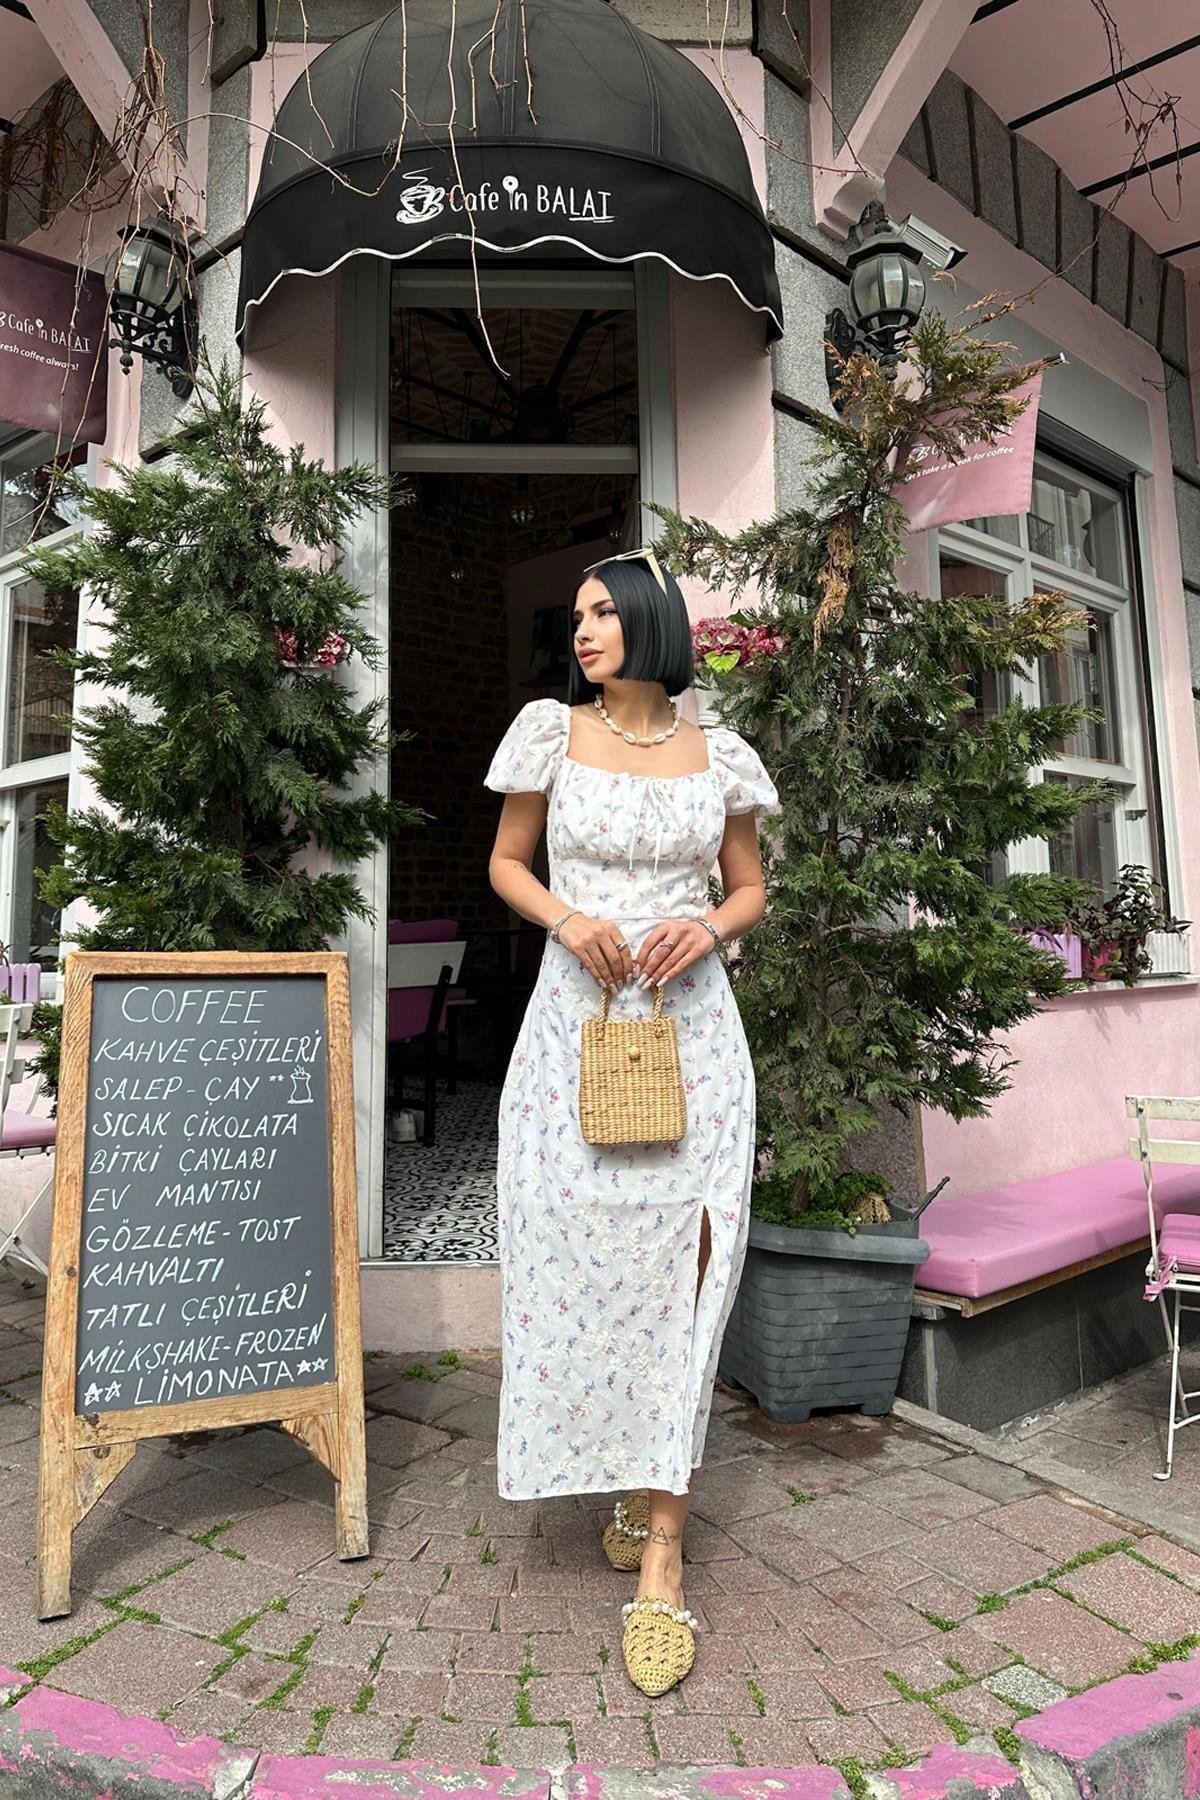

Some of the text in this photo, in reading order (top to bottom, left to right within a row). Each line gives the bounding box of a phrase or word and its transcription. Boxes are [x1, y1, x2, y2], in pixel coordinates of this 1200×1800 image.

[449, 175, 615, 222] Cafe in BALAT
[8, 313, 34, 335] Cafe
[51, 328, 91, 352] BAAT
[0, 343, 19, 354] resh
[20, 349, 45, 363] coffee
[922, 465, 940, 476] take
[973, 452, 986, 461] for
[986, 447, 1014, 457] coffee
[121, 986, 269, 1024] COFFEE
[94, 1029, 322, 1067] KAHVE ÇEŞİTLERİ
[94, 1076, 182, 1101] SALEP
[204, 1076, 260, 1106] ÇAY
[92, 1110, 298, 1142] SICAK ÇİKOLATA
[88, 1144, 277, 1177] BİTKİ ÇAYLARI
[87, 1179, 262, 1213] EV MANTISI
[83, 1255, 225, 1288] KAHVALTI
[86, 1269, 312, 1331] TATLI ÇEŞİTLERİ
[134, 1360, 294, 1405] LİMONATA
